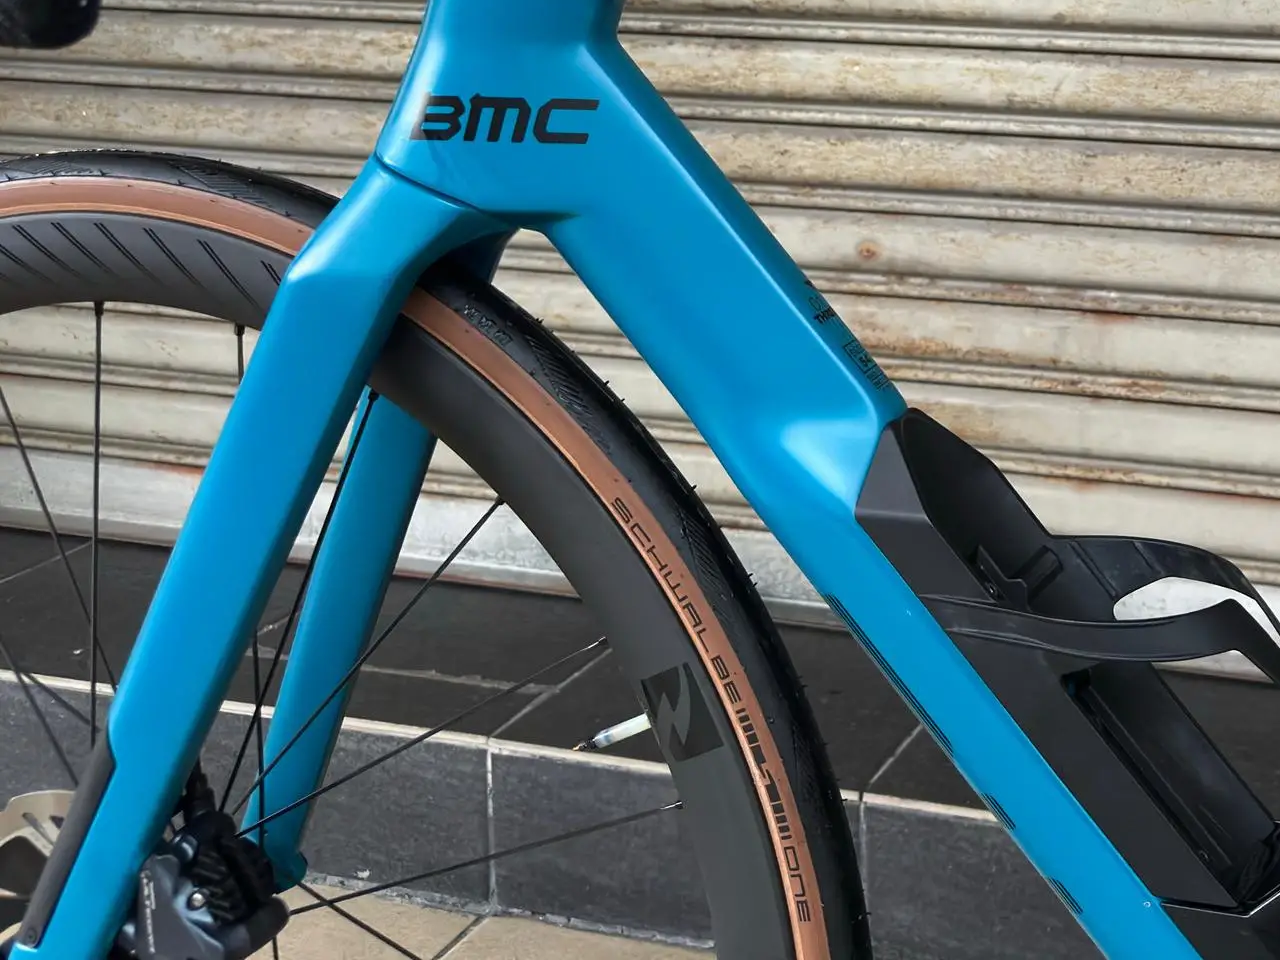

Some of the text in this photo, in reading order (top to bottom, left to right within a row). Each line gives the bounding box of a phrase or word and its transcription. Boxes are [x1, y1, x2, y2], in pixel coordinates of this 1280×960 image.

[409, 92, 600, 145] BMC
[610, 496, 812, 923] SCHWALBE ONE
